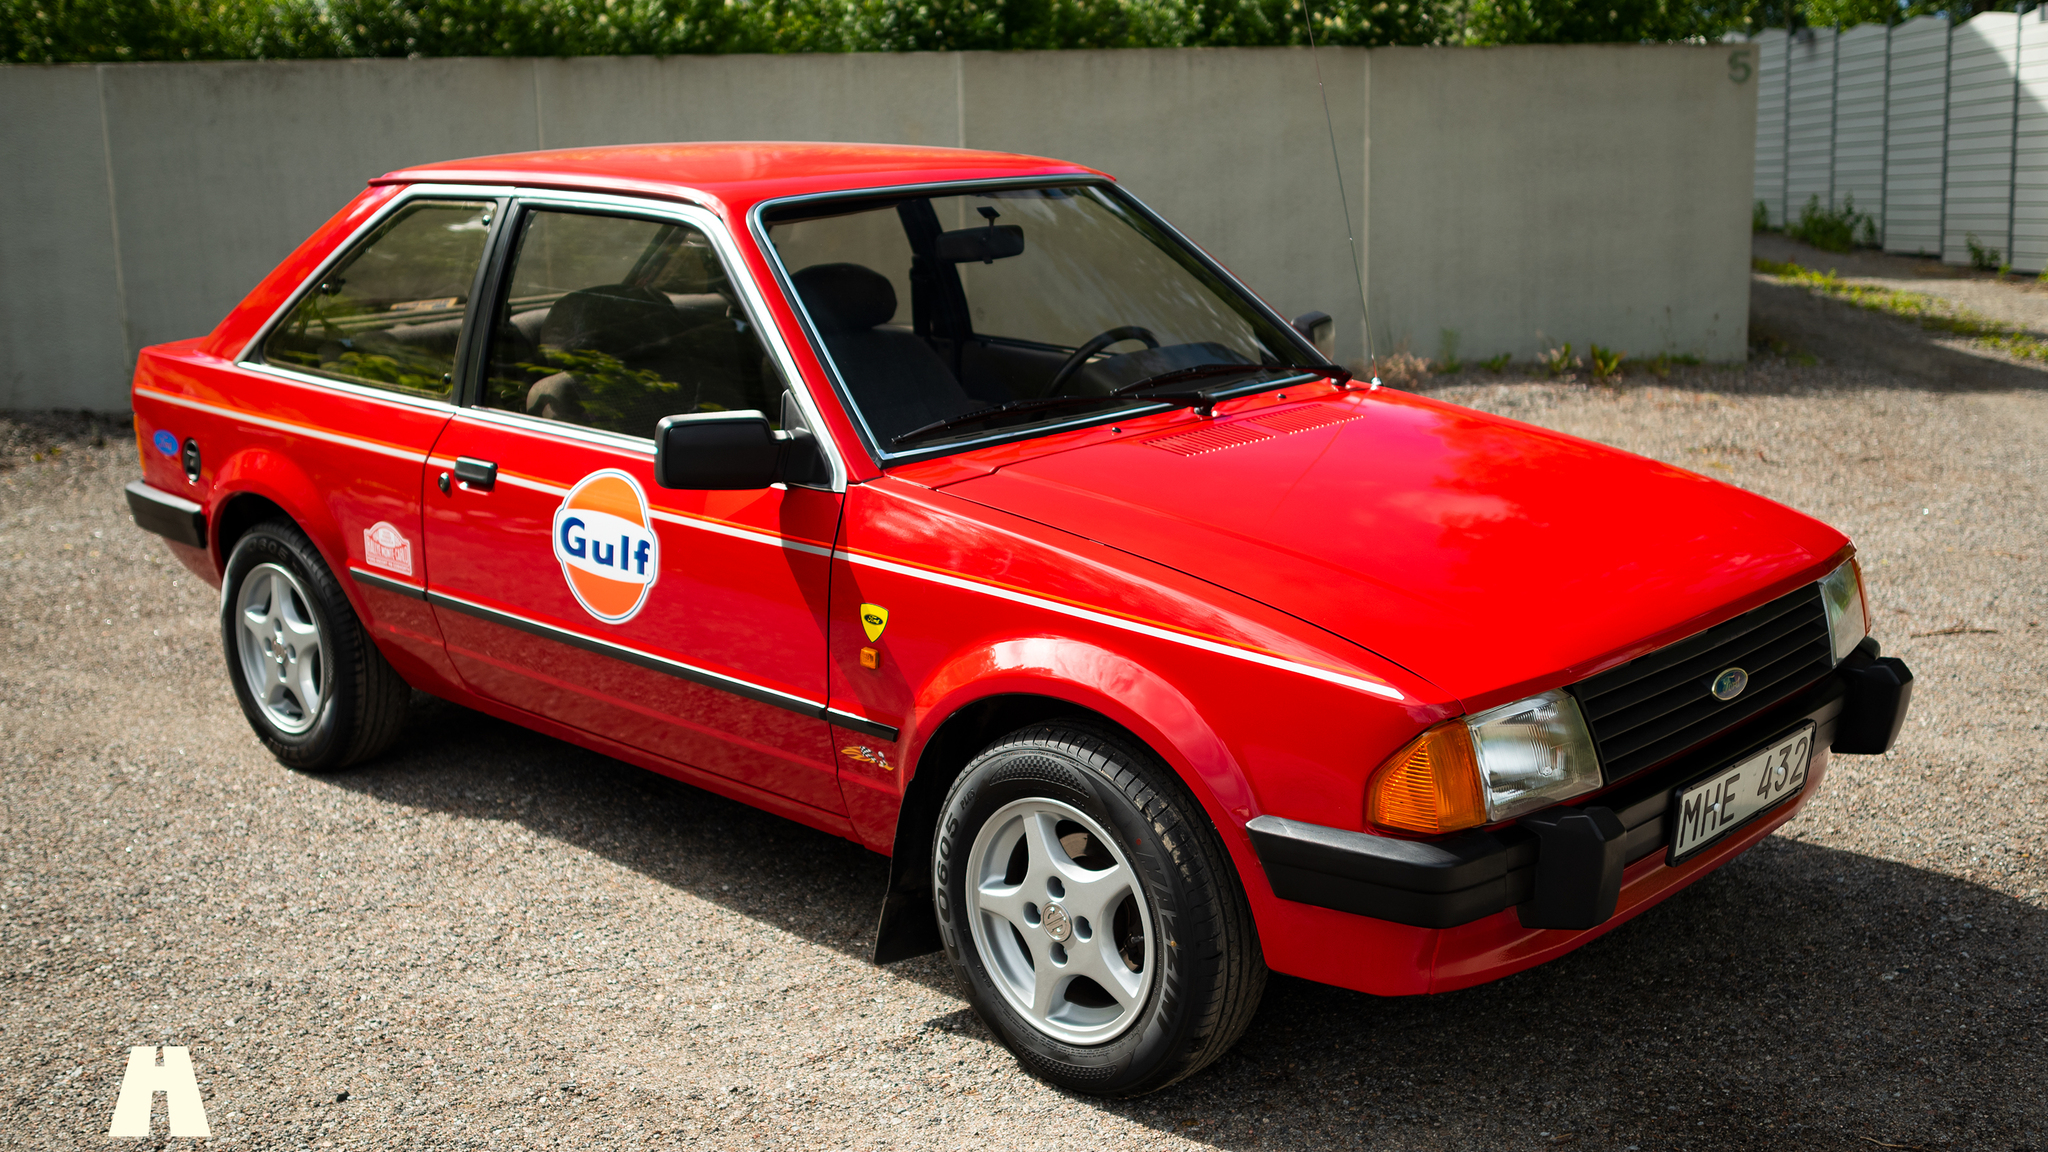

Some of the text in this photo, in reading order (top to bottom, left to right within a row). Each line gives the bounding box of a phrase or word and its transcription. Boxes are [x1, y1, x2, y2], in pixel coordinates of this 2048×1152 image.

[1728, 50, 1752, 84] 5
[560, 516, 651, 576] Gulf
[1679, 736, 1808, 849] MHE 432
[1136, 851, 1183, 1038] MAZZINI
